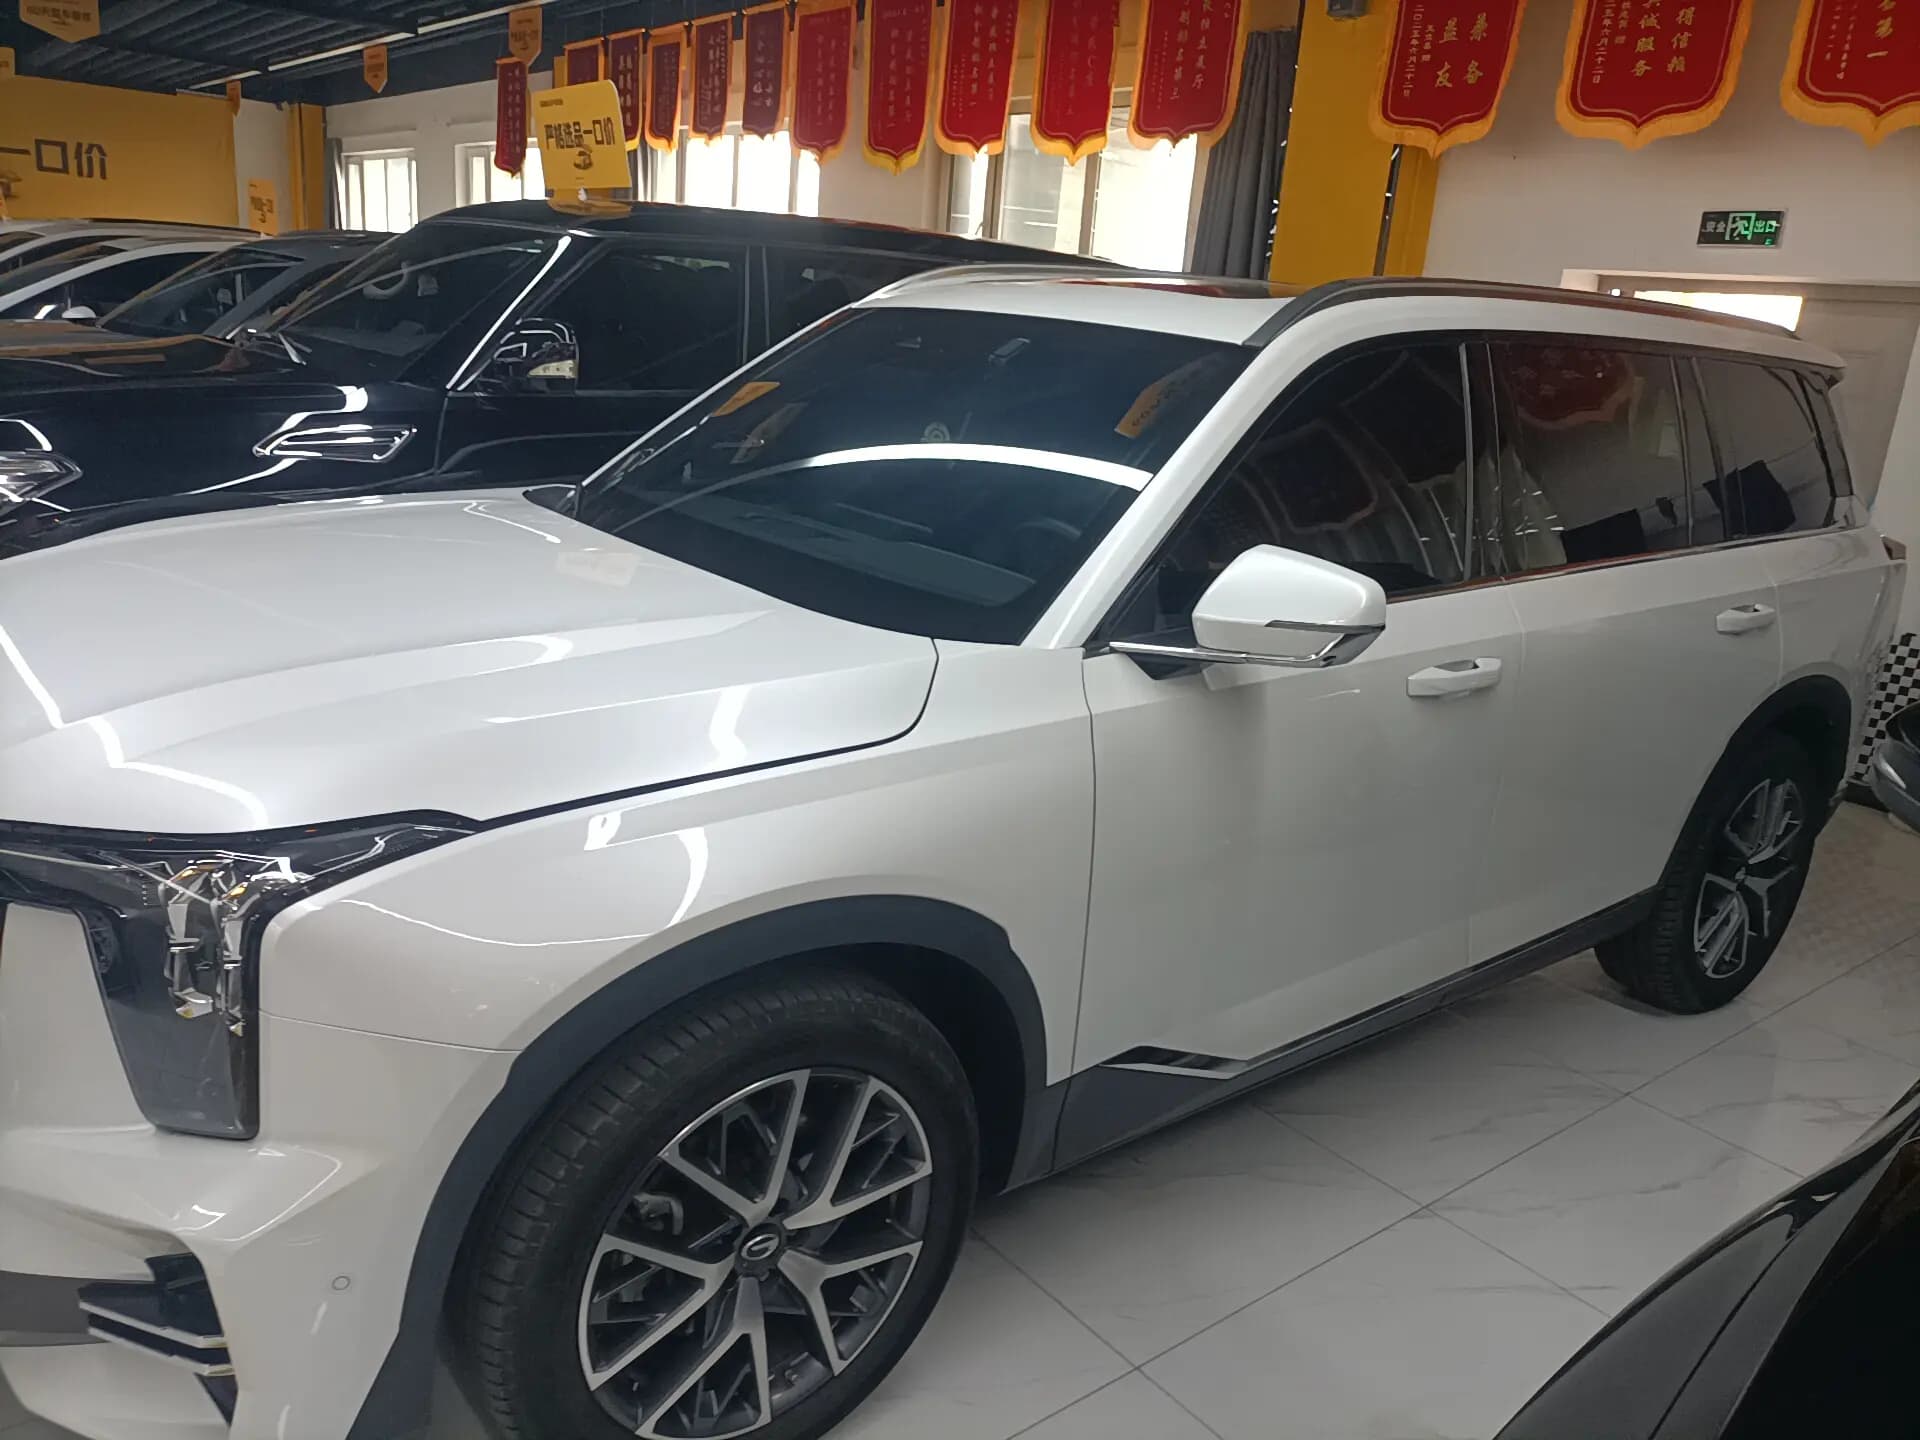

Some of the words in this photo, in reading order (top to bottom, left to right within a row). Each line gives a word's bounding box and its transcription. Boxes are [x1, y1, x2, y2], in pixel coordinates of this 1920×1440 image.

[544, 116, 616, 150] 严格选品一口价
[0, 138, 108, 180] 一口价
